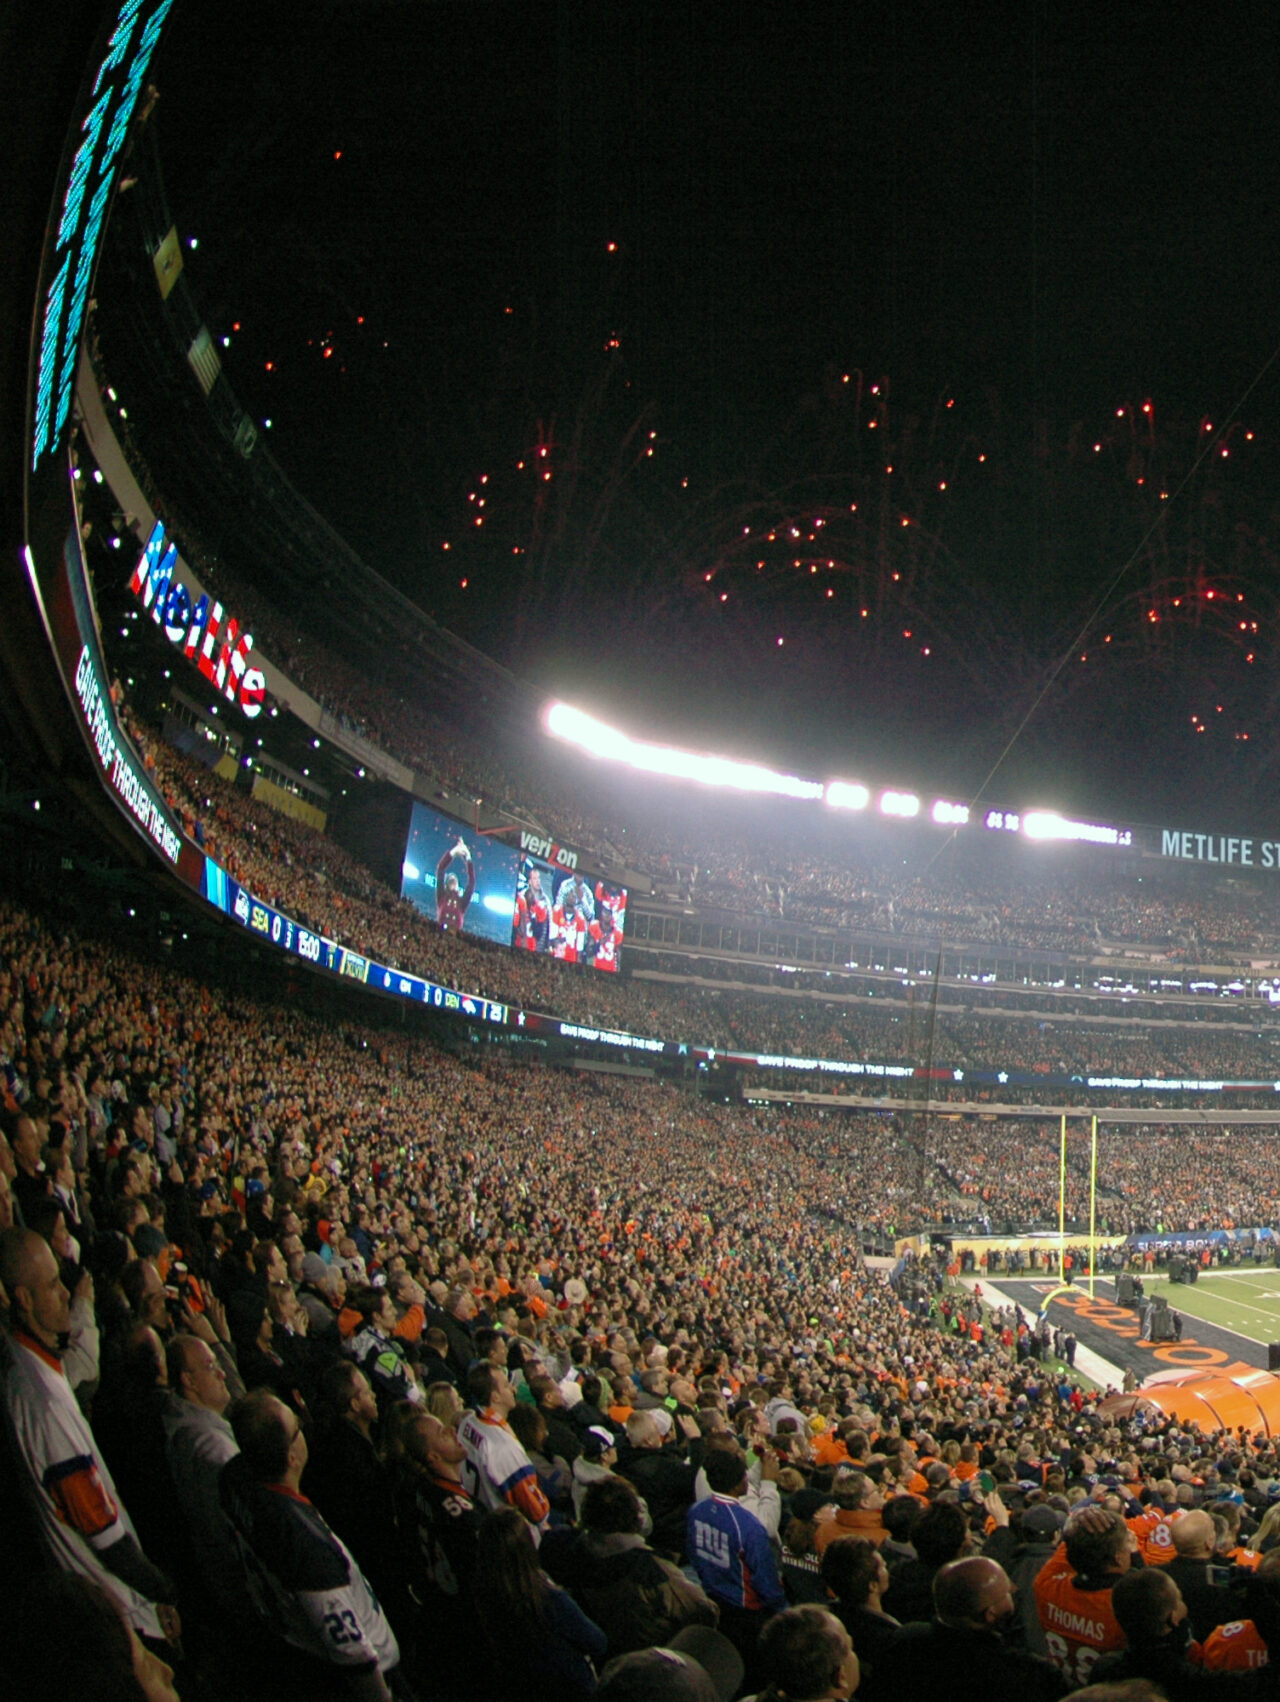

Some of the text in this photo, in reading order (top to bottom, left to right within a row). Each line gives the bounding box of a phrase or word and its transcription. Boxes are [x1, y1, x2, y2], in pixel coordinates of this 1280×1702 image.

[130, 519, 266, 718] MetLife
[111, 748, 151, 827] THROUGH
[149, 804, 165, 844] THE
[520, 831, 577, 870] verizon
[1162, 829, 1253, 866] METLIFE
[251, 905, 270, 934] SEA
[272, 915, 282, 942] 0
[444, 993, 460, 1009] DEN
[322, 1609, 363, 1645] 23
[1047, 1602, 1105, 1641] THOMAS
